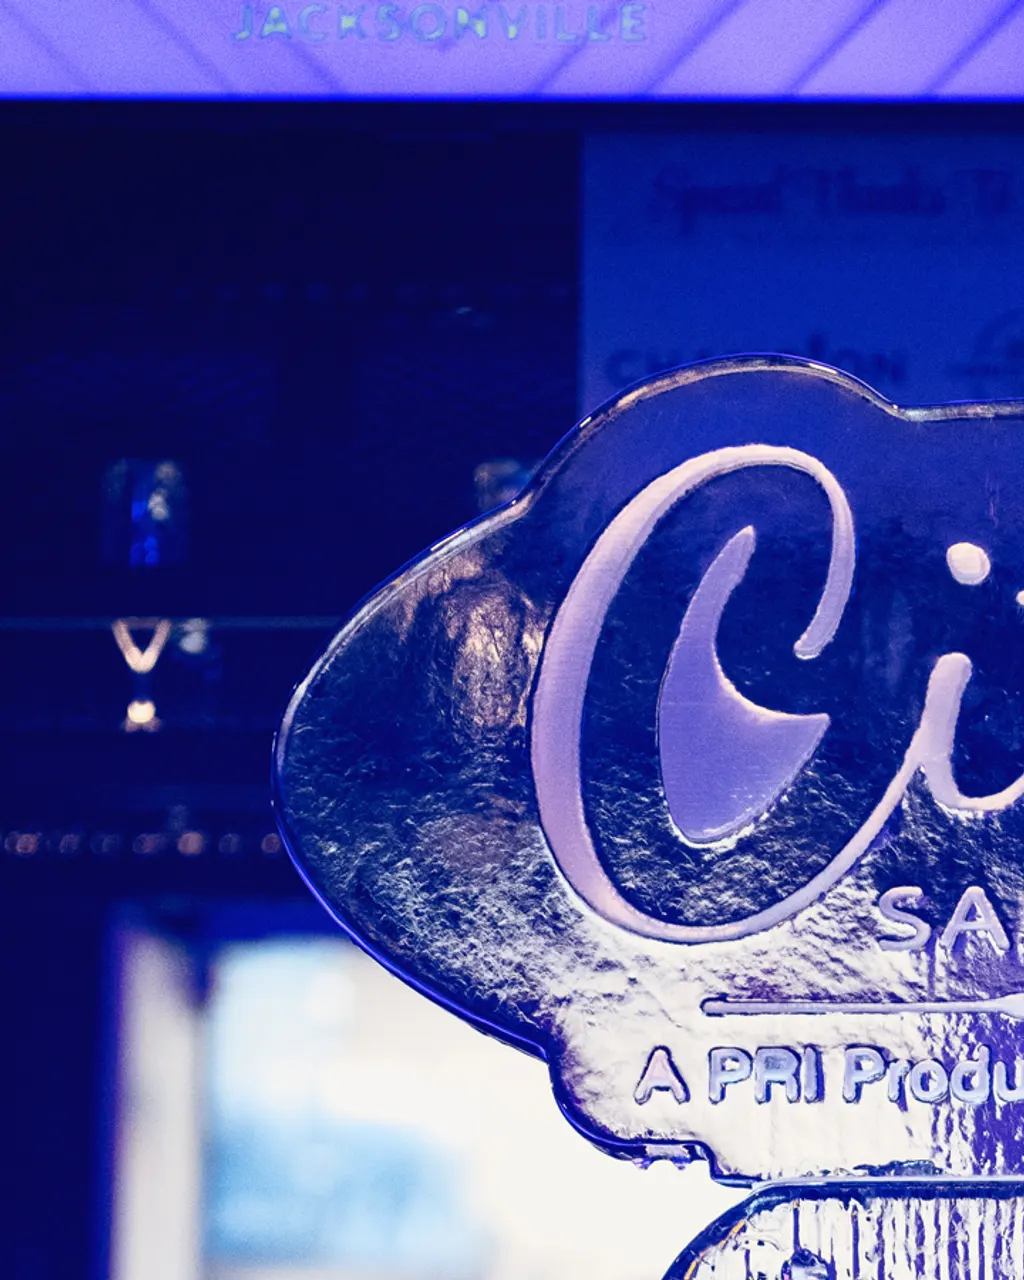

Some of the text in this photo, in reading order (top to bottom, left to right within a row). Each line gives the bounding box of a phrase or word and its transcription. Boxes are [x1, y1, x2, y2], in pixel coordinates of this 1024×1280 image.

[230, 2, 647, 42] JACKSONVILLE
[632, 1045, 689, 1105] A
[706, 1045, 824, 1105] PRI
